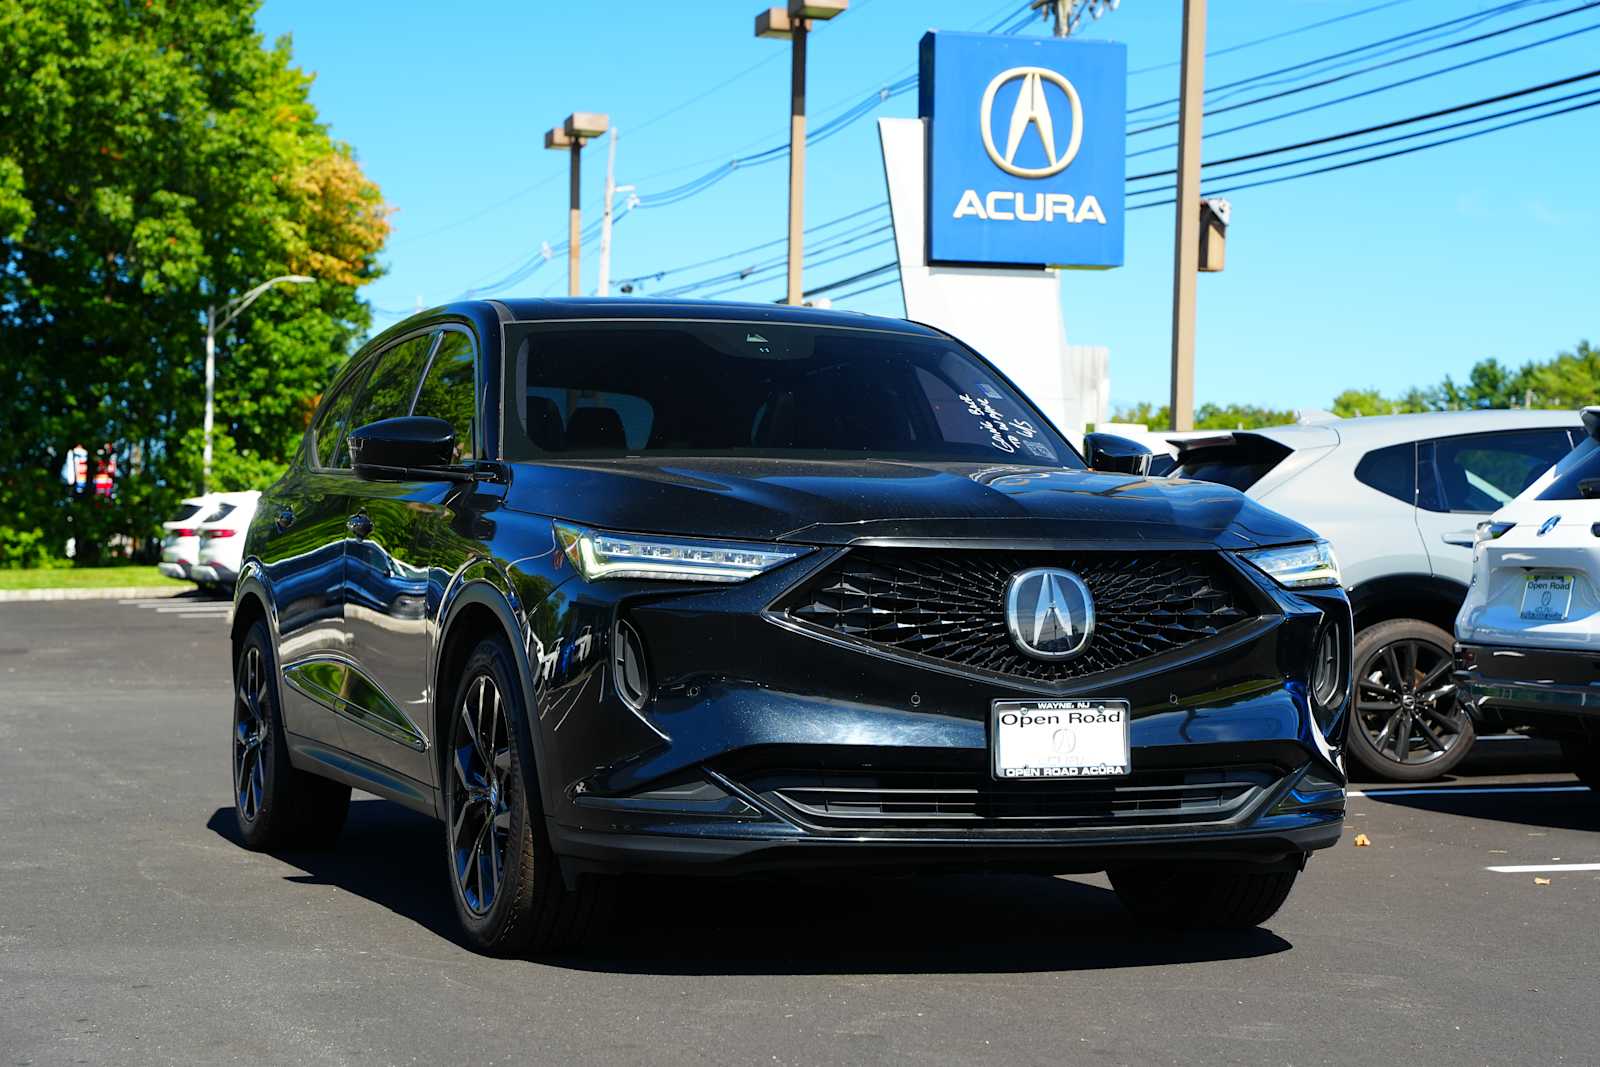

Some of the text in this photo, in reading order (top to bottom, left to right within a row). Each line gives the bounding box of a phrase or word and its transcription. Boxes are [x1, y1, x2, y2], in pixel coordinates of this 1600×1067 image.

[952, 189, 1107, 225] ACURA
[1528, 582, 1570, 590] Open Road
[1001, 712, 1120, 728] Open Road
[1006, 766, 1124, 777] OPEN ROAD ACURA
